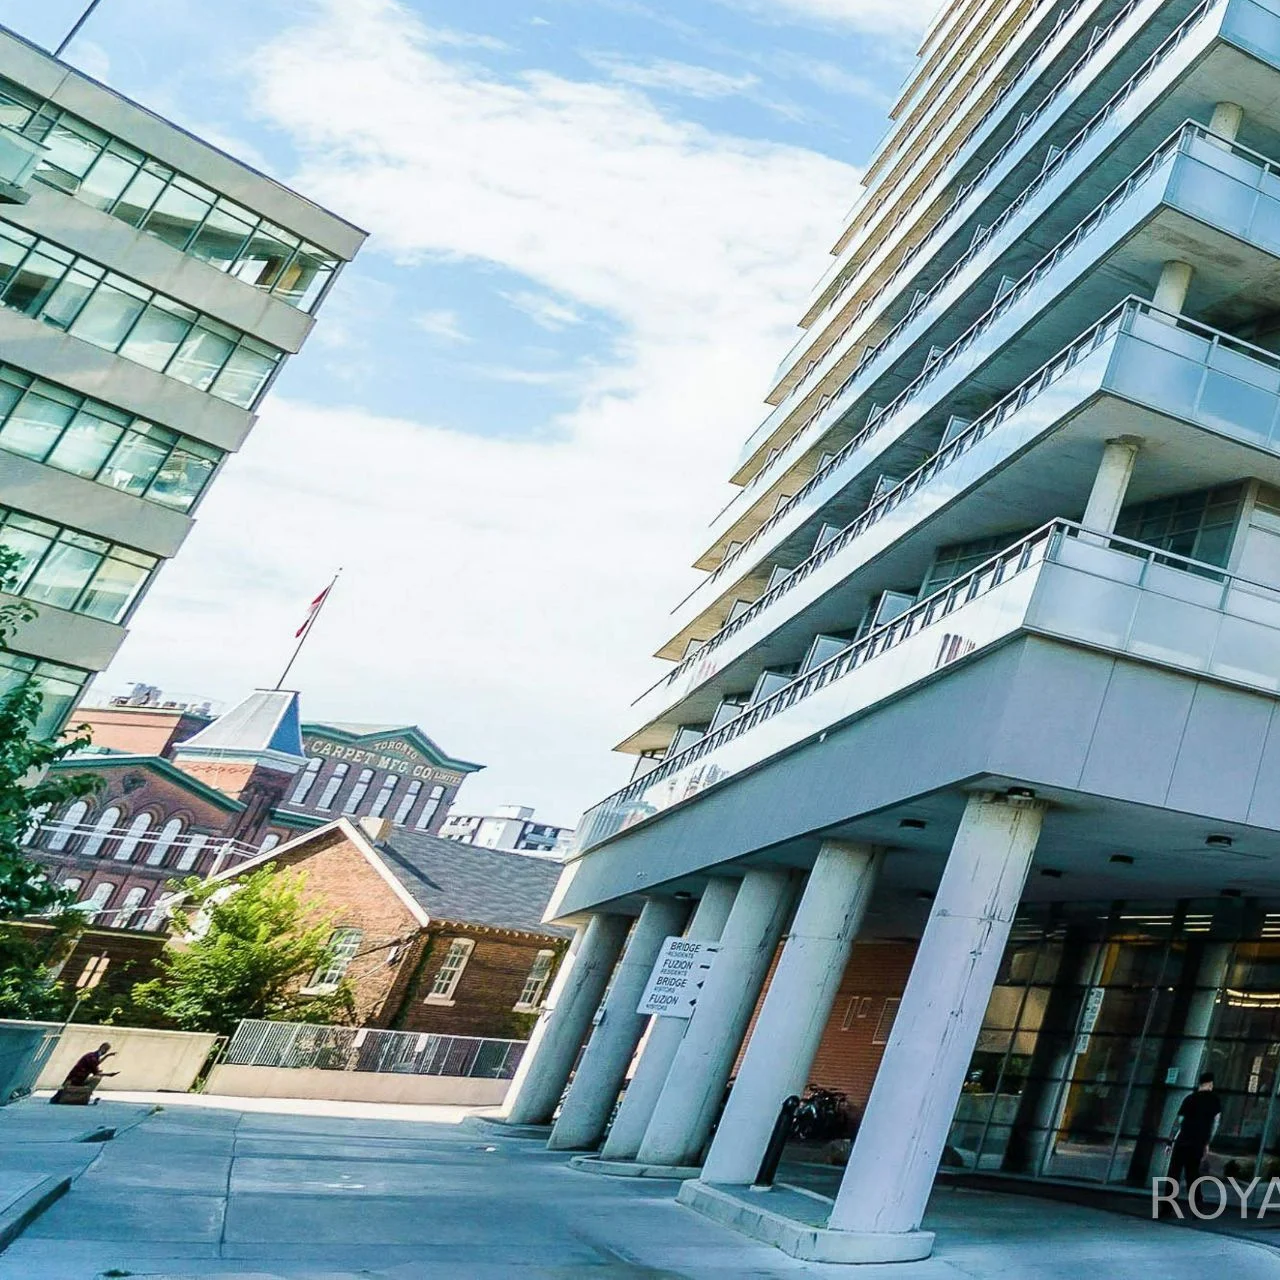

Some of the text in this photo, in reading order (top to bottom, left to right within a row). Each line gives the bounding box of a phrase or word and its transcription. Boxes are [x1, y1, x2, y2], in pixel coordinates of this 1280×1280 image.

[311, 740, 376, 764] CARPET
[375, 741, 417, 760] TORONTO
[670, 941, 701, 953] BRIDGE
[663, 959, 694, 970] FUZION
[656, 976, 688, 988] BRIDGE
[648, 993, 679, 1005] FUZION
